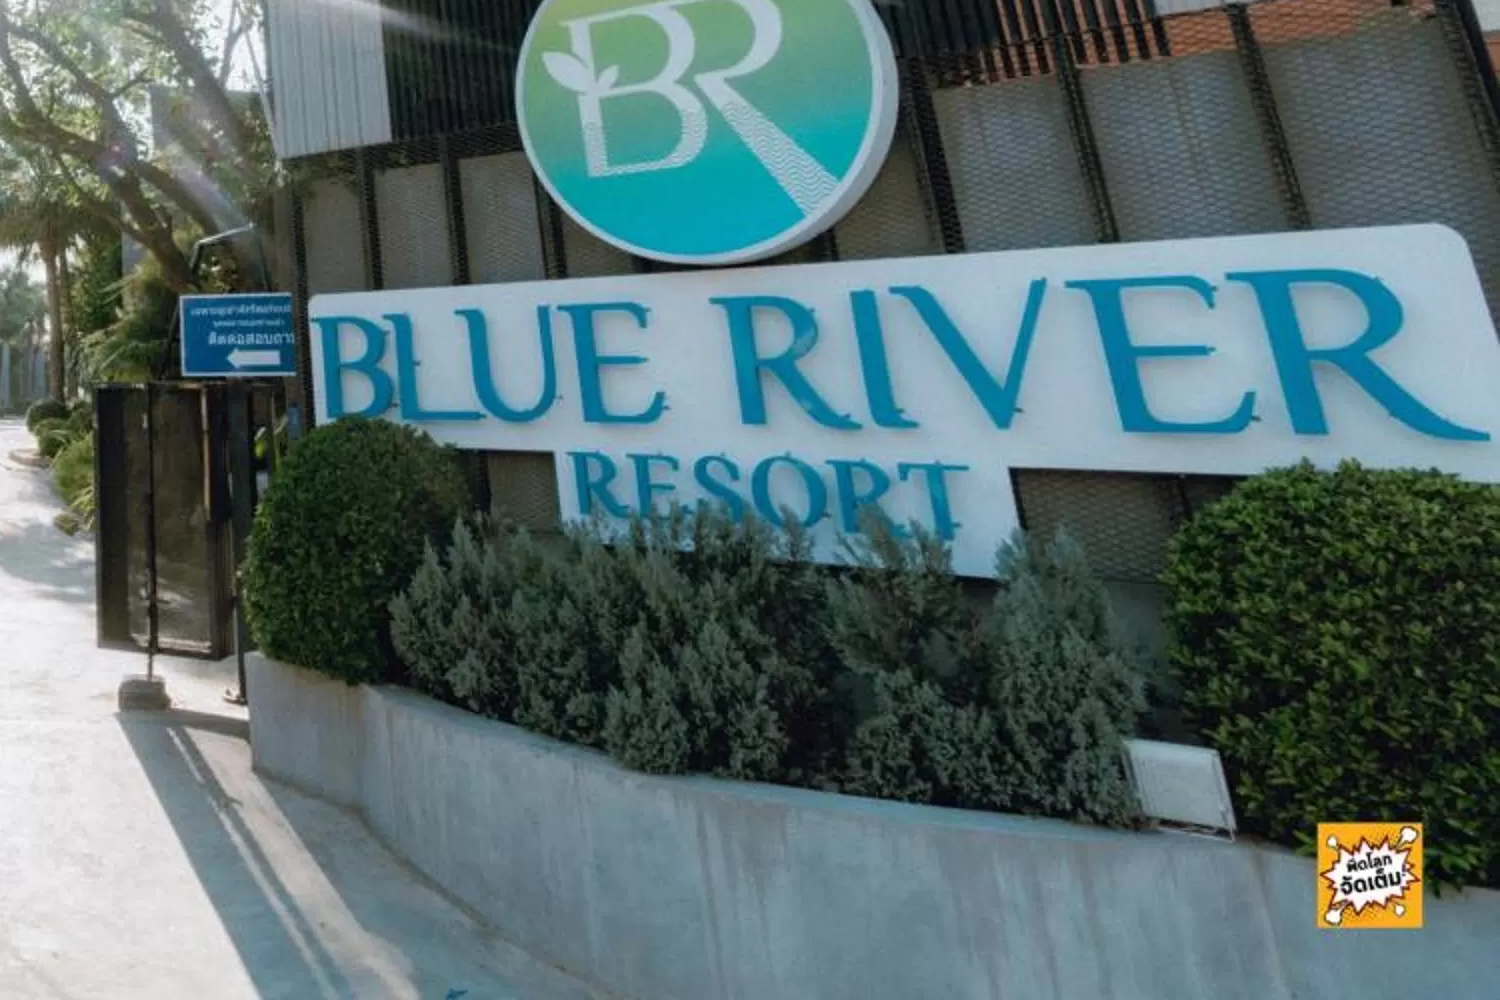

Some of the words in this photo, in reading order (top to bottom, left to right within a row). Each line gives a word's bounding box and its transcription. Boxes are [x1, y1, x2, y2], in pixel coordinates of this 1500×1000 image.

[312, 301, 670, 424] BLUE
[710, 266, 1490, 440] RIVER
[566, 449, 970, 541] RESORT
